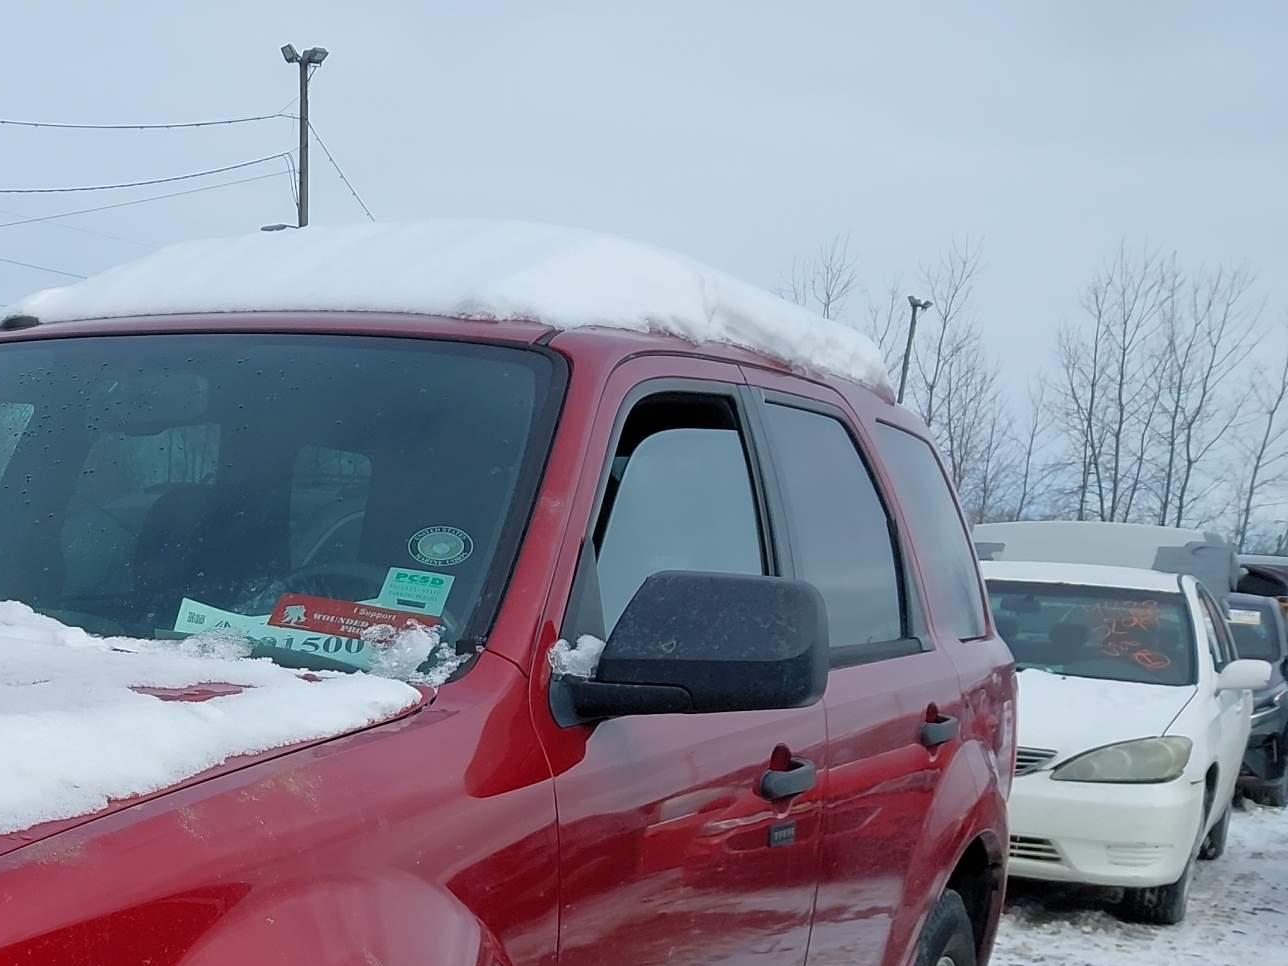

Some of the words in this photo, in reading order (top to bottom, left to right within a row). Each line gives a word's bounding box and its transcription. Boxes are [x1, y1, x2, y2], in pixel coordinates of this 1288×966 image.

[396, 572, 444, 585] PCSD
[312, 613, 369, 628] WOUNDED
[359, 607, 397, 621] Support
